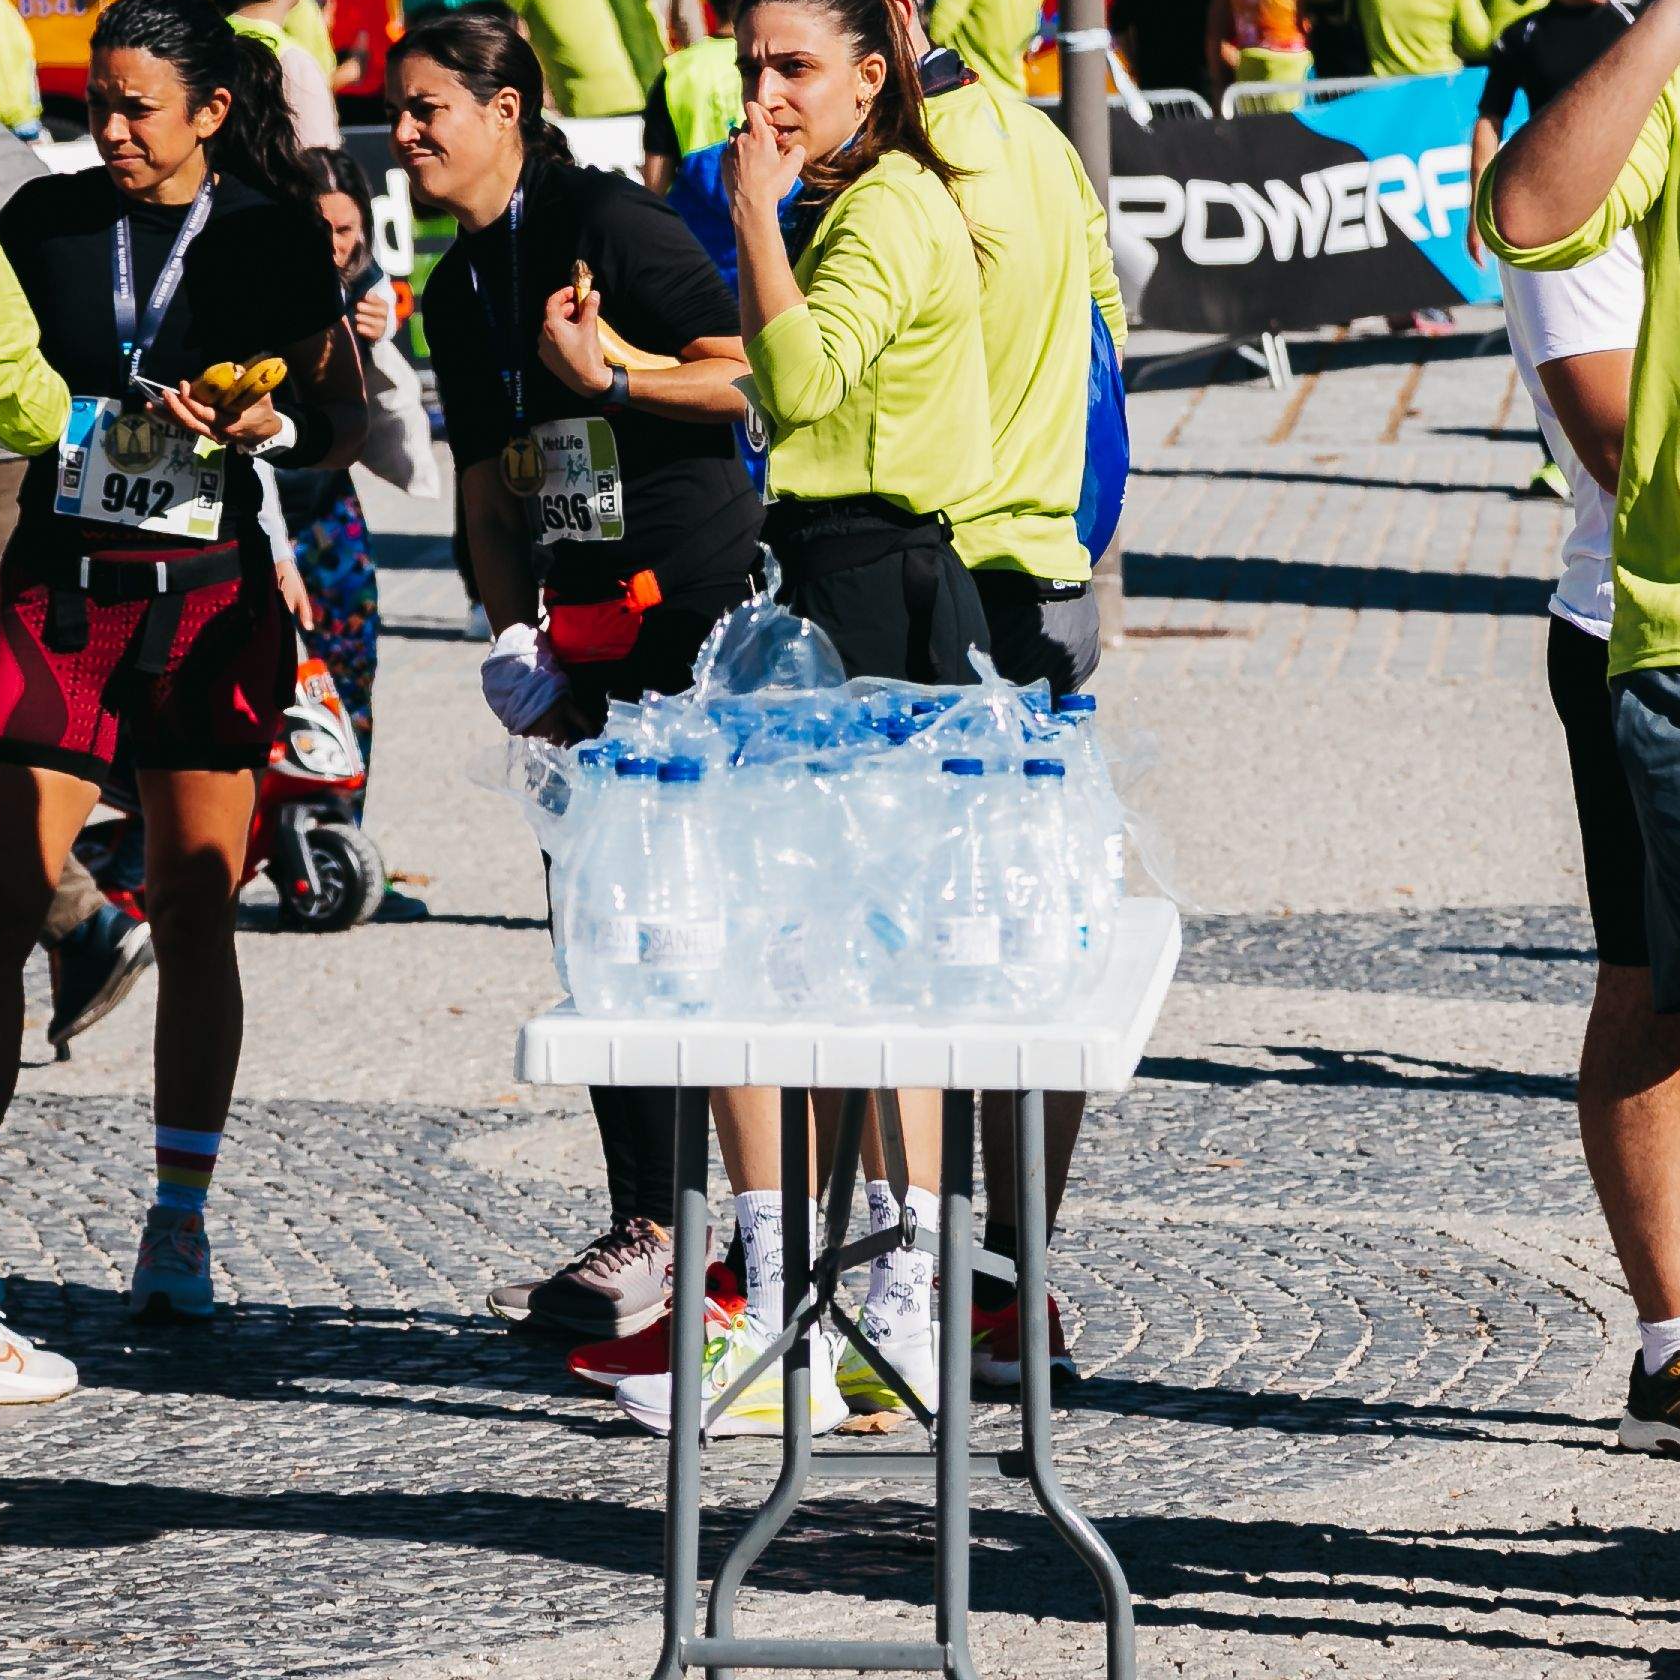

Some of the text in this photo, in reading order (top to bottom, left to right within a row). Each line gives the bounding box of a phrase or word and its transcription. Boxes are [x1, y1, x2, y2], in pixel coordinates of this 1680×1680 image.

[542, 434, 584, 451] MetLife
[101, 472, 175, 519] 942
[541, 492, 593, 532] 626
